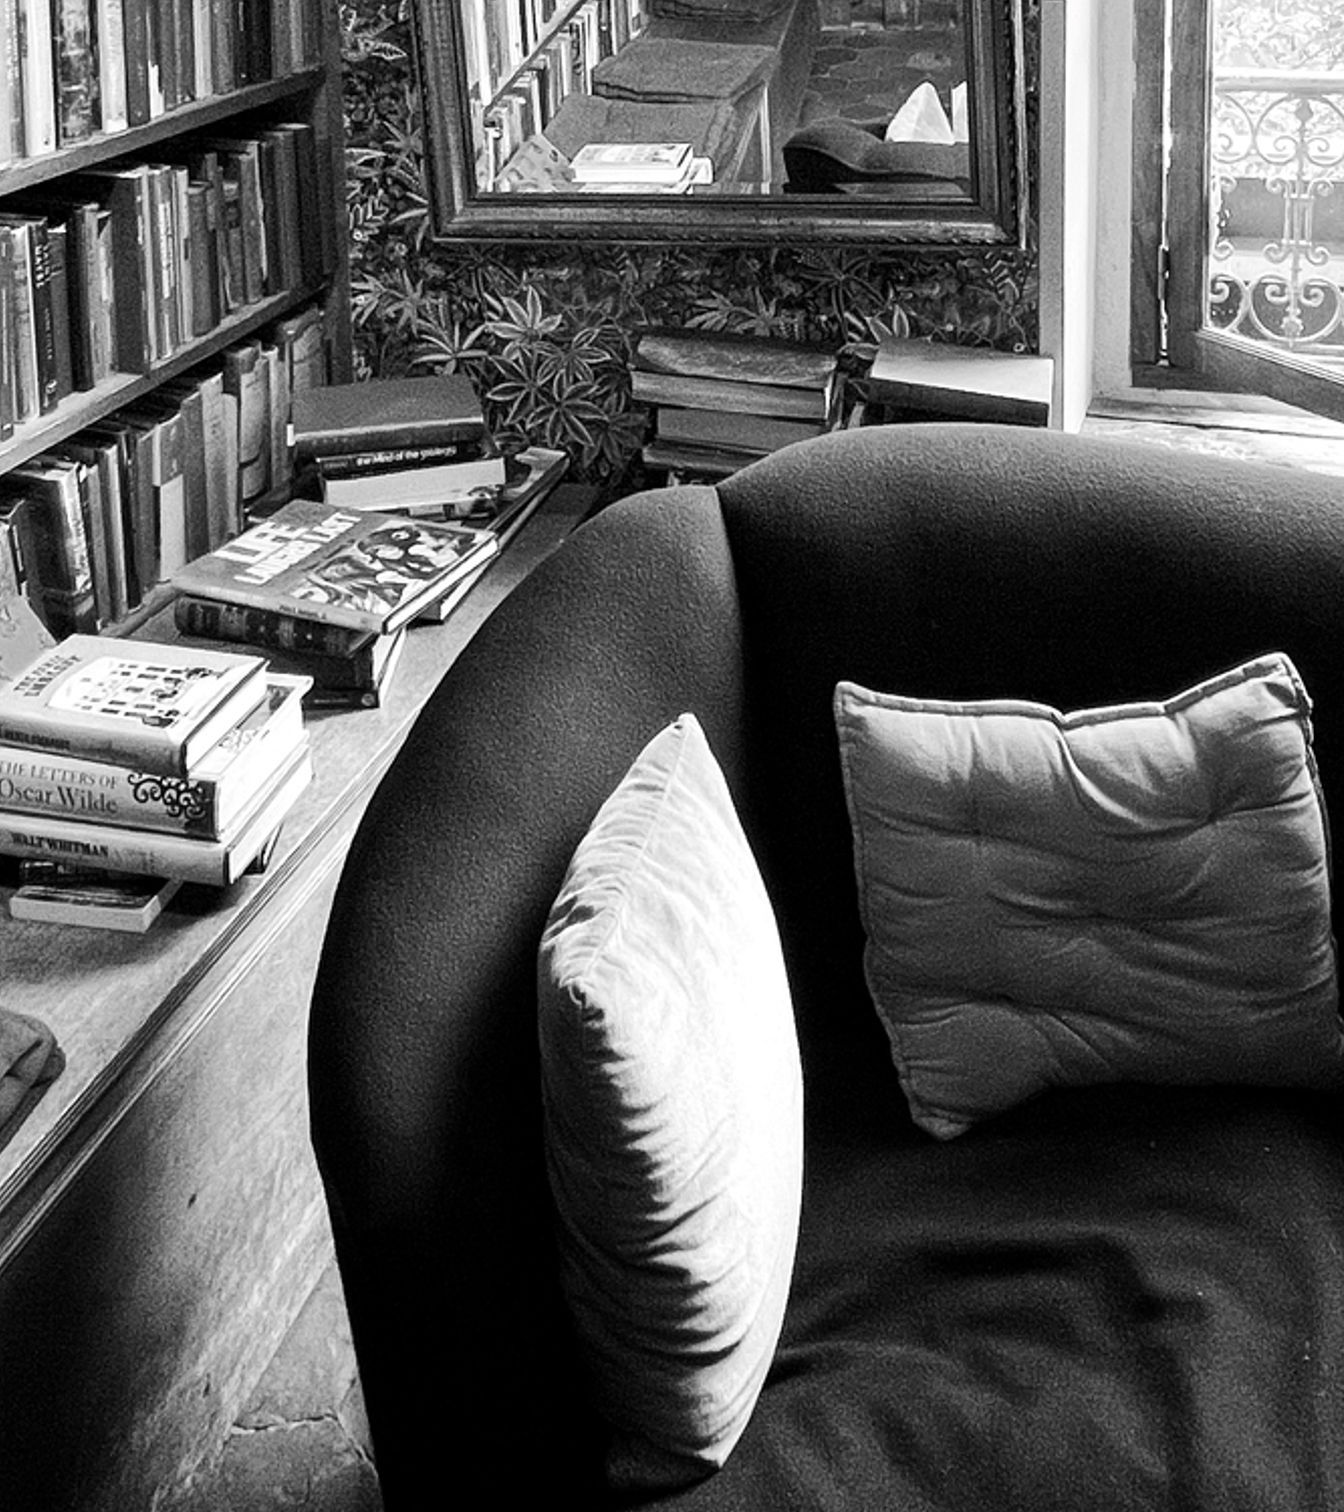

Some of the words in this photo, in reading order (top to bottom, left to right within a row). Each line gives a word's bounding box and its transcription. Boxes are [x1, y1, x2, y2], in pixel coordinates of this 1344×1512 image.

[210, 519, 311, 564] LIFE
[299, 512, 362, 545] LAST
[30, 762, 95, 787] LETTERS
[98, 774, 118, 788] OF
[53, 785, 118, 815] Wilde
[10, 832, 40, 847] WALT
[36, 834, 108, 858] WHITMAN
